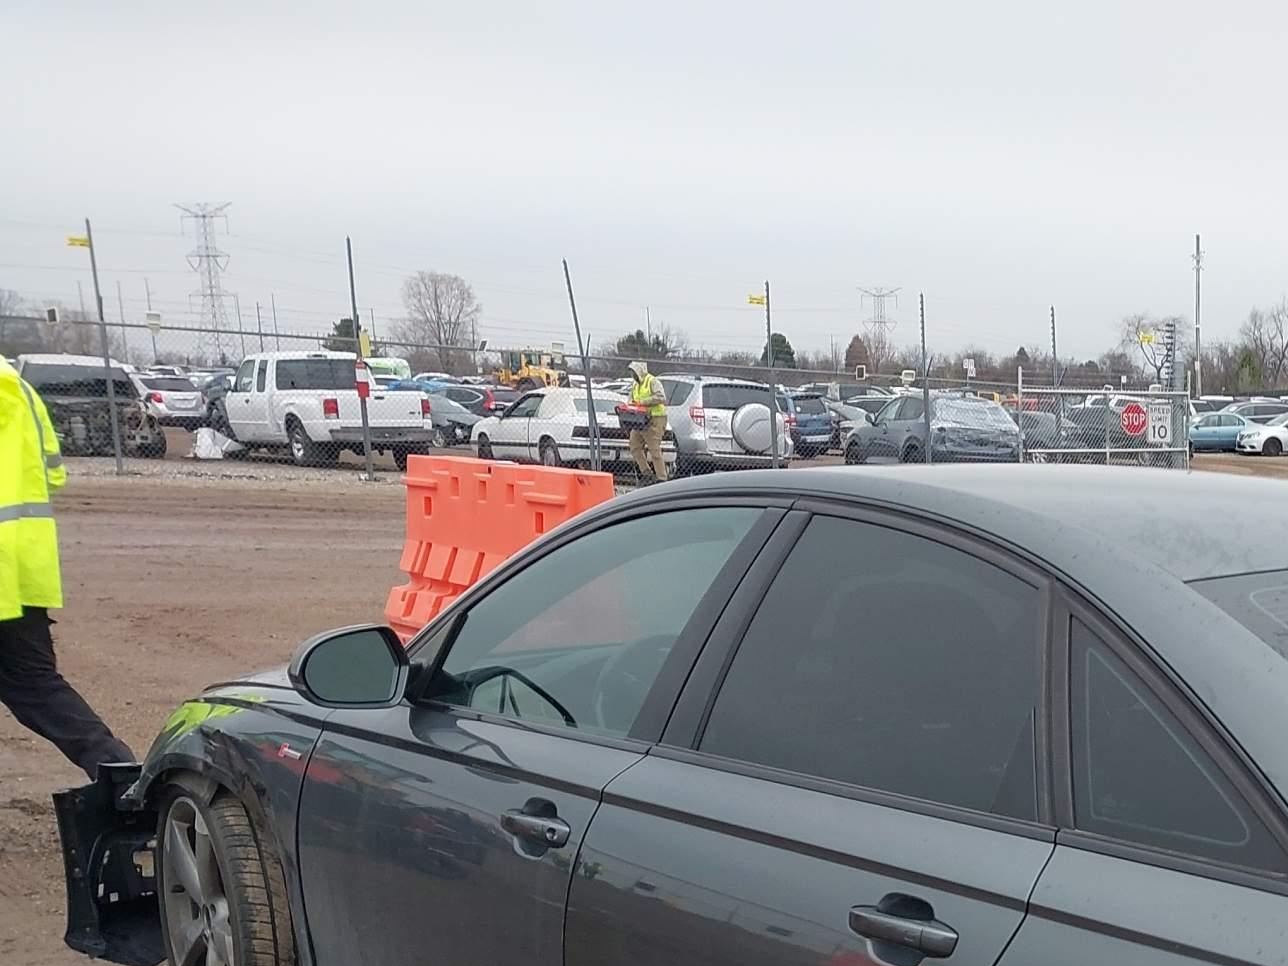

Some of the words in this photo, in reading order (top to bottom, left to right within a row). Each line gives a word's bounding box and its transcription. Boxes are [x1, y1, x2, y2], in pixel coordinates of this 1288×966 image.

[1150, 407, 1170, 415] SPEED
[1123, 413, 1146, 426] STOP
[1152, 425, 1168, 439] 10
